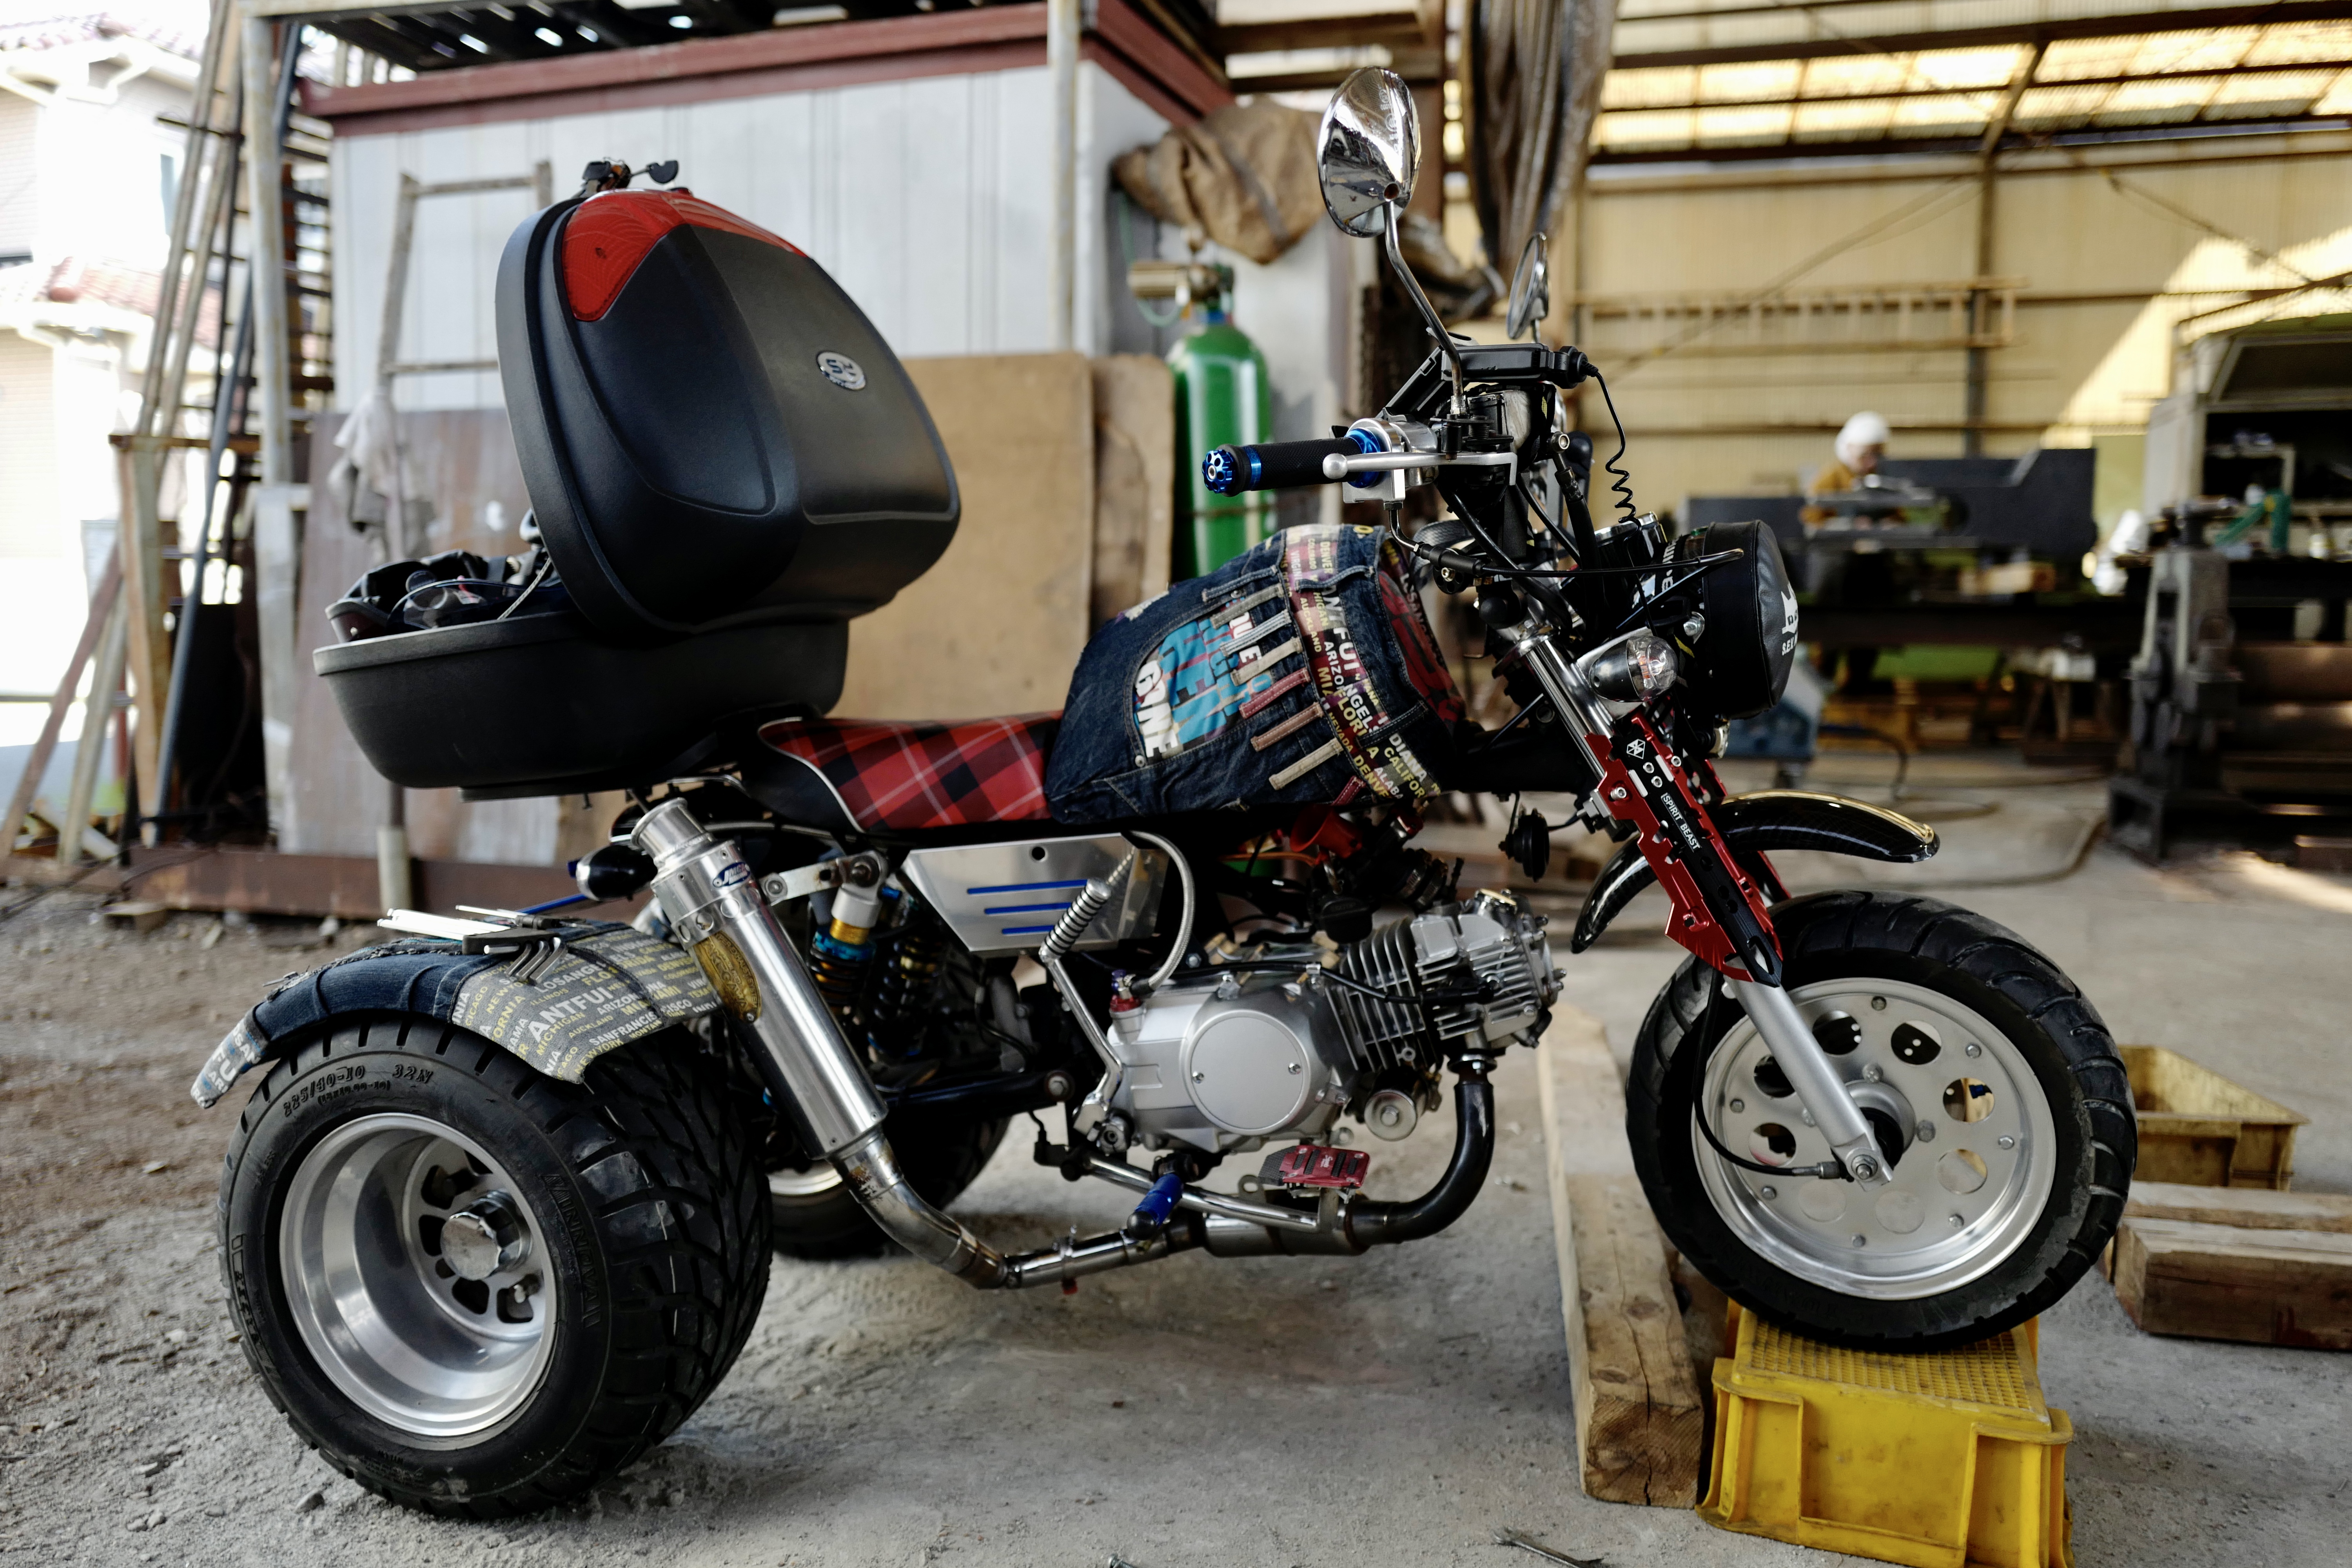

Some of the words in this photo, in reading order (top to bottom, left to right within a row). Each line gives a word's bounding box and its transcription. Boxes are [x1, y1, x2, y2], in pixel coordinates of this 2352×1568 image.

[1300, 597, 1322, 652] AUCKLAND
[1135, 660, 1178, 758] GONE
[1663, 795, 1682, 820] SPIRIT
[1680, 824, 1700, 849] BEAST
[528, 986, 613, 1043] ANTFUI
[530, 988, 569, 1005] ILLINOIS
[536, 1012, 586, 1056] MICHIGAN
[568, 1015, 614, 1039] AUCKLAND
